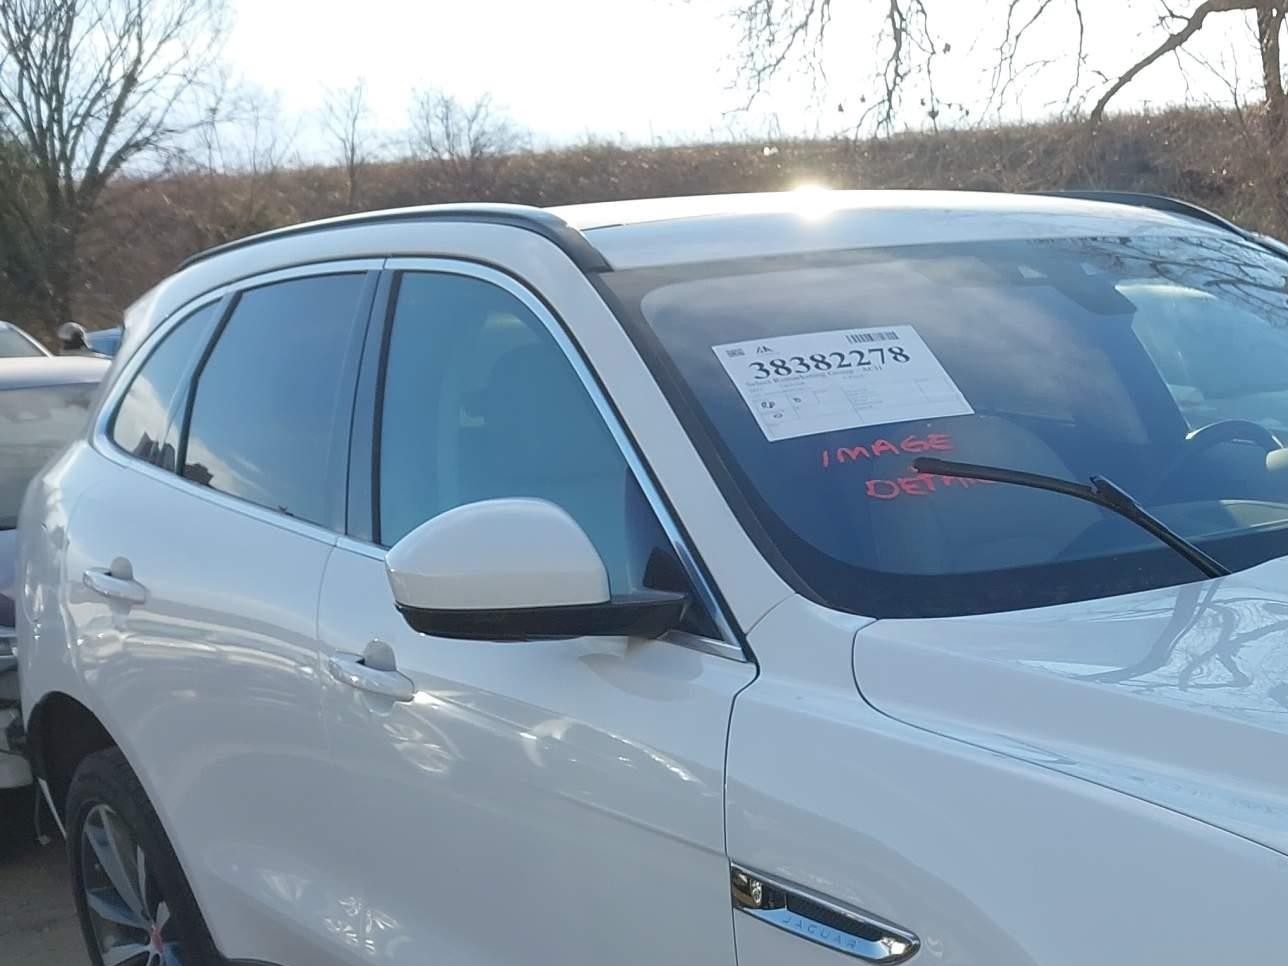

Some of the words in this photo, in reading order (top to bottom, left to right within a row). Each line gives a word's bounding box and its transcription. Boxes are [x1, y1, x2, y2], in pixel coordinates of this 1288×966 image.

[749, 345, 911, 380] 38382278
[820, 434, 953, 466] IMAGE
[783, 914, 858, 949] JAGUAR
